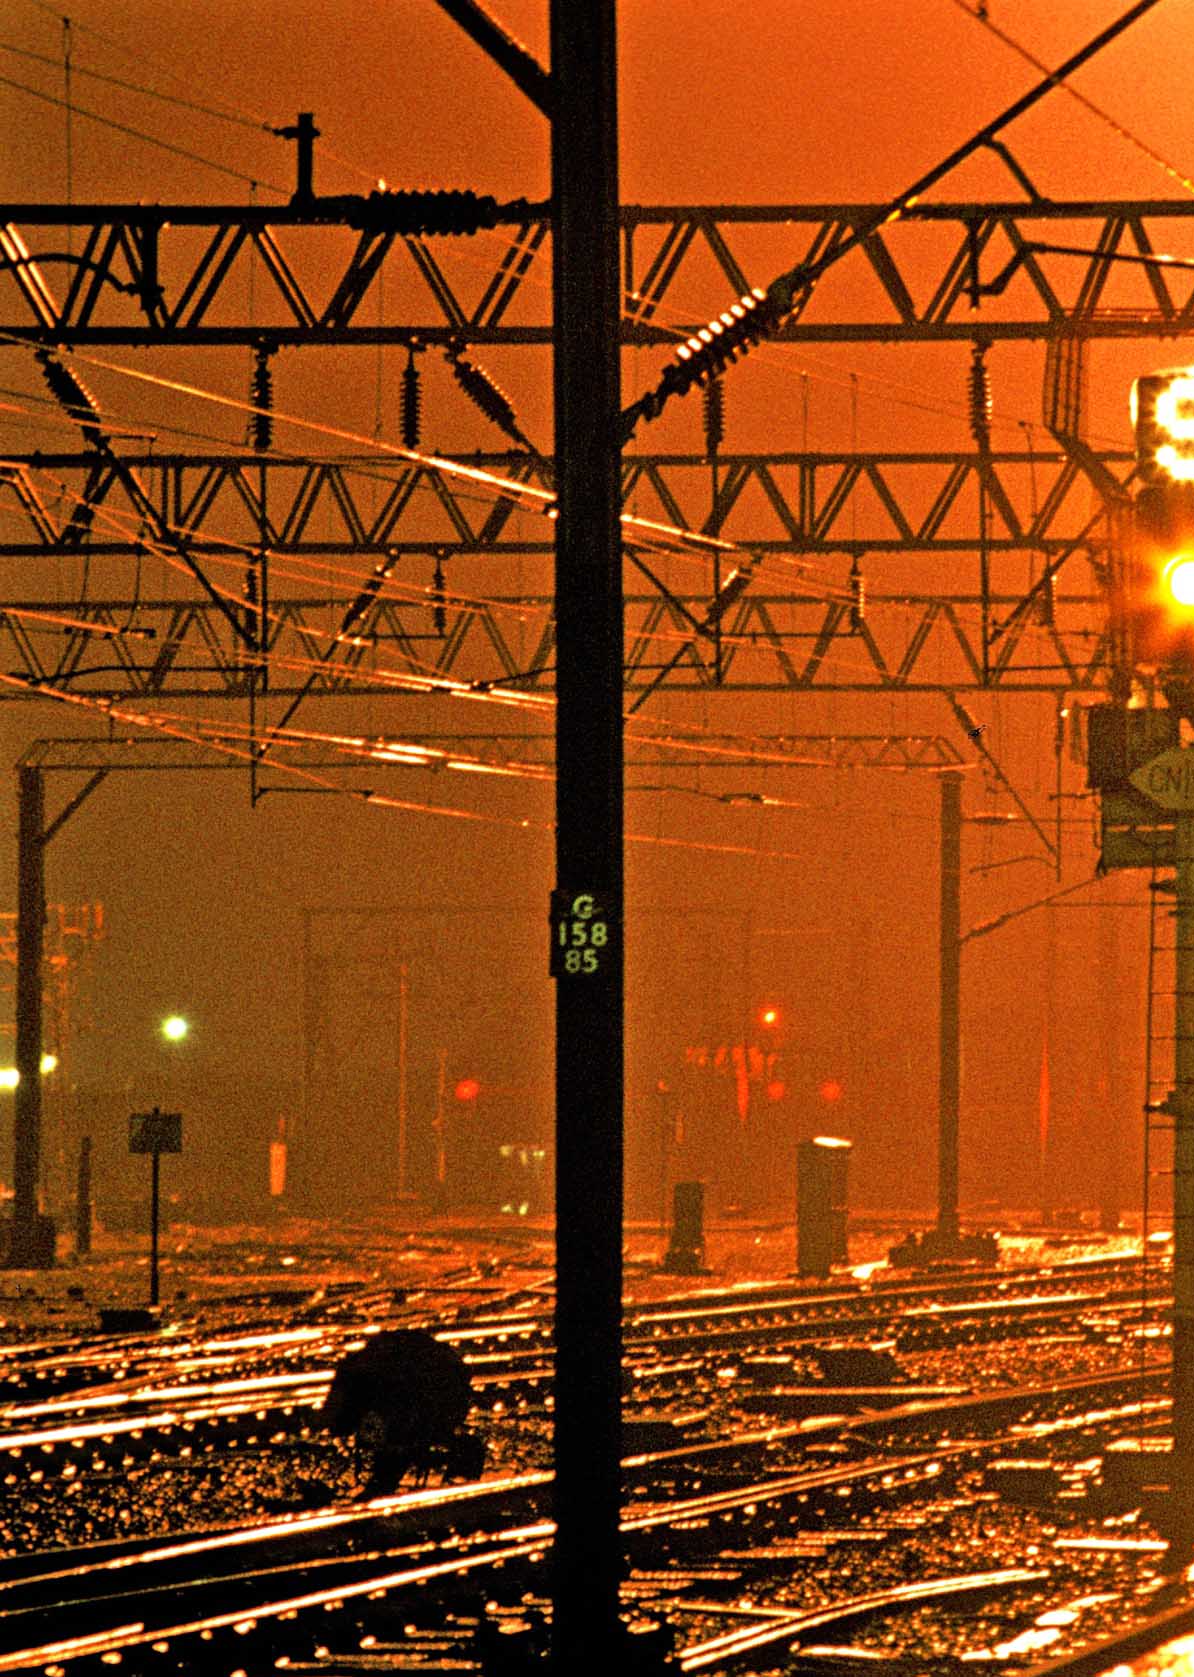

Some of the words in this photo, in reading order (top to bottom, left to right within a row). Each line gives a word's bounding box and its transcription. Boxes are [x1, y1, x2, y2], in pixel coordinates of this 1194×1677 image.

[572, 894, 596, 919] G
[559, 921, 608, 947] 158
[565, 949, 599, 974] 85
